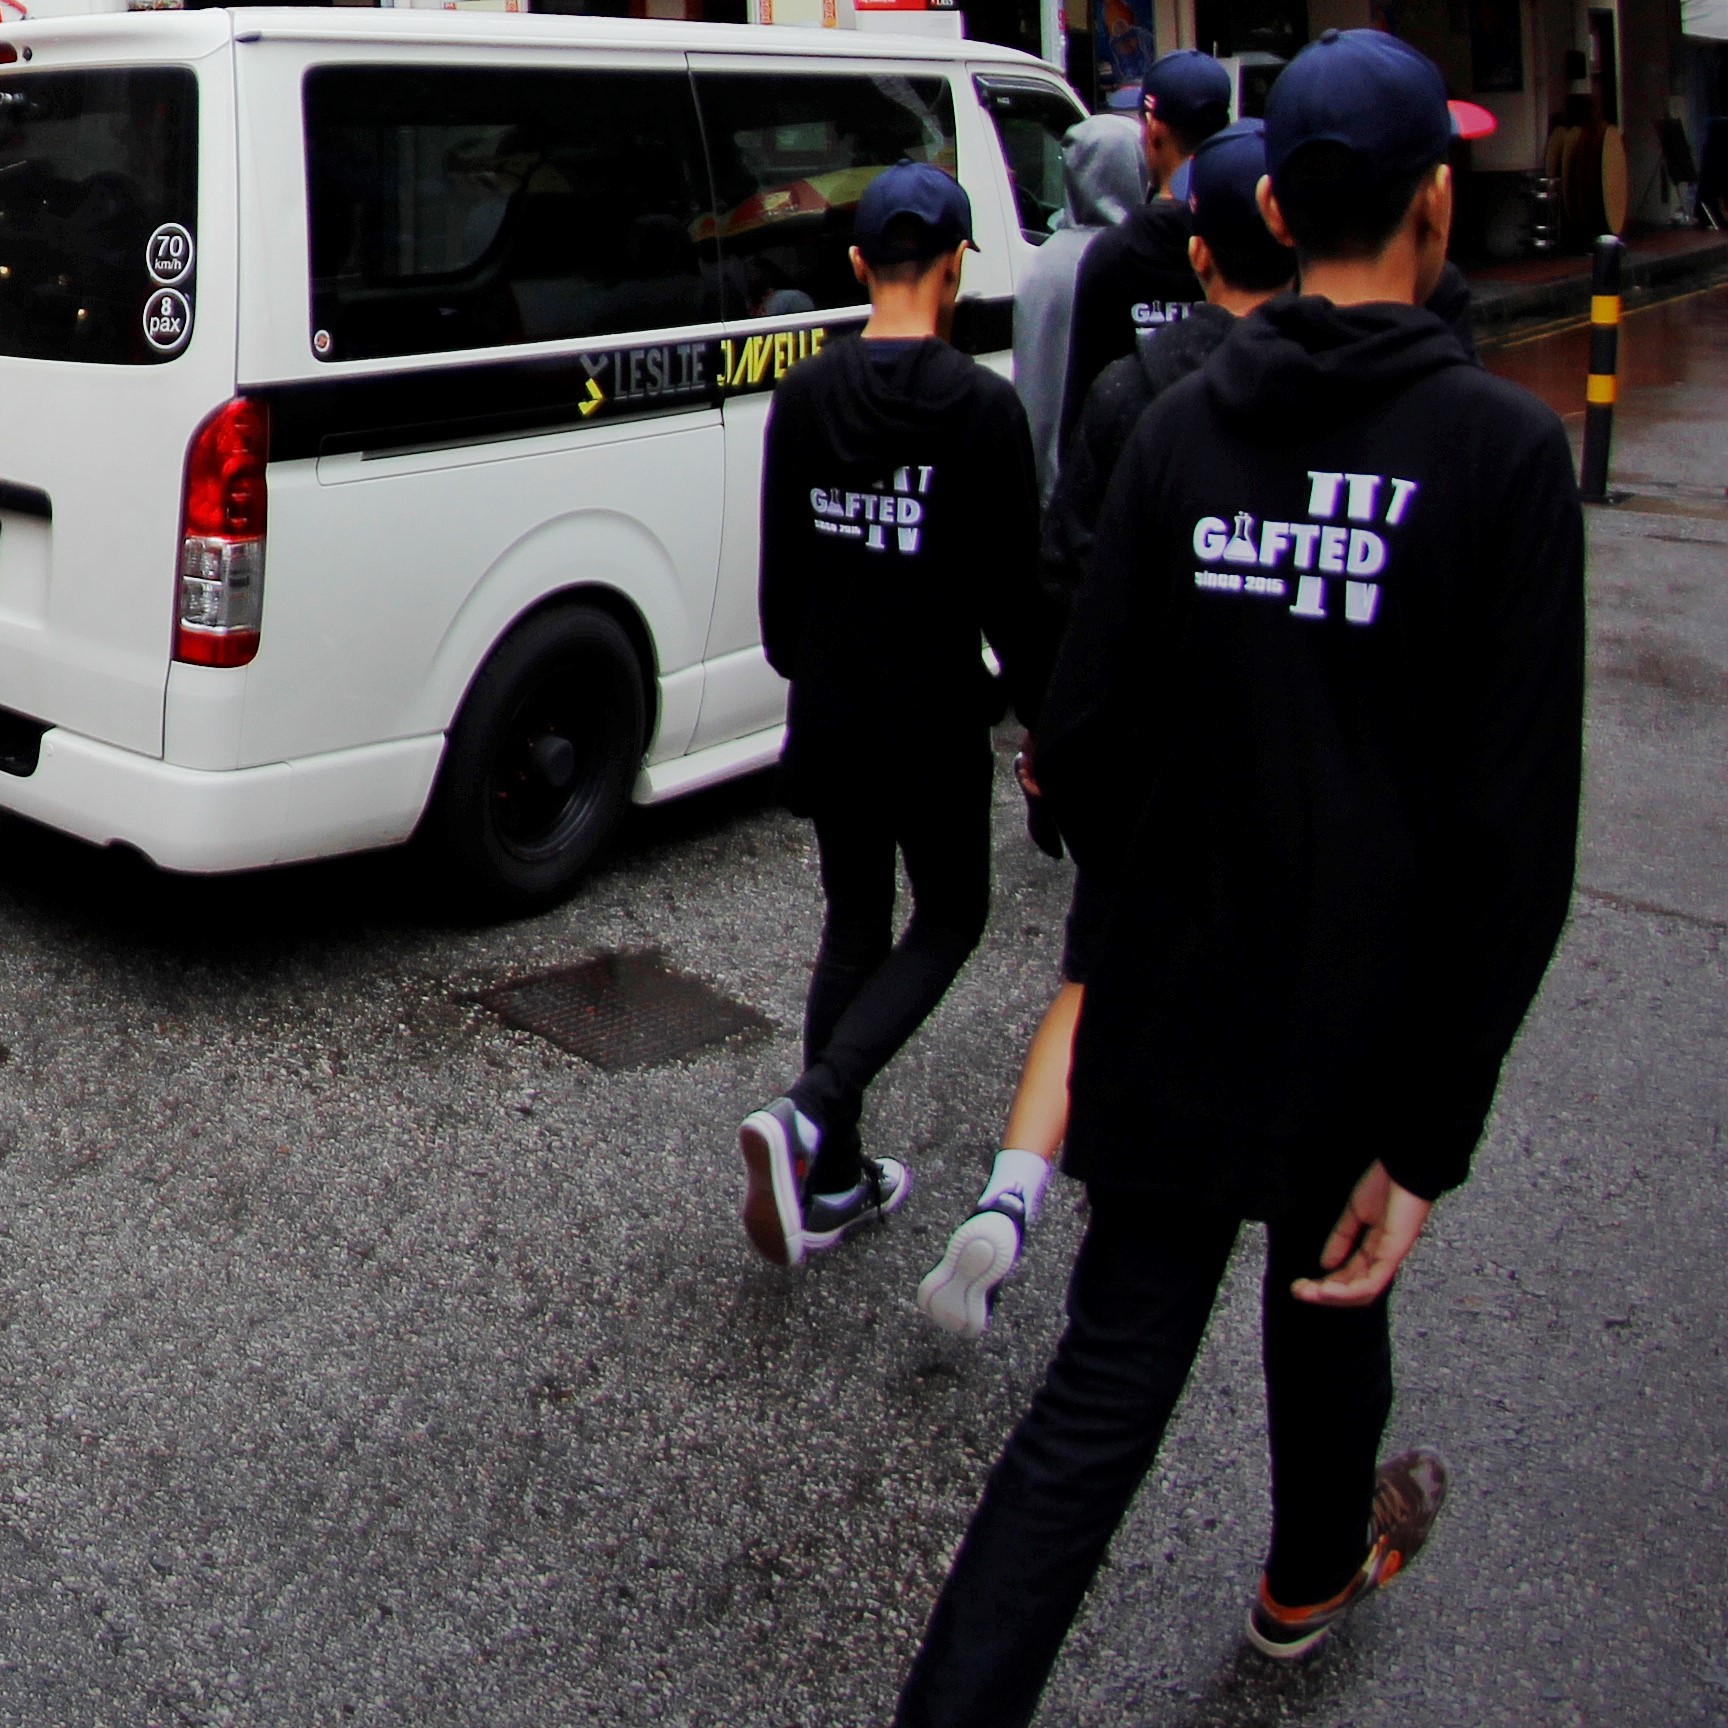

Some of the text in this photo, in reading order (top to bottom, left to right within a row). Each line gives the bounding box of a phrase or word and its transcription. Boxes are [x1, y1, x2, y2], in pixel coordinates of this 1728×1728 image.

[157, 235, 183, 257] 70
[154, 258, 182, 270] km/h
[161, 296, 172, 316] 8
[149, 316, 180, 335] pax
[614, 328, 825, 400] LESLIE JAVELLE
[1194, 570, 1285, 594] since 2015
